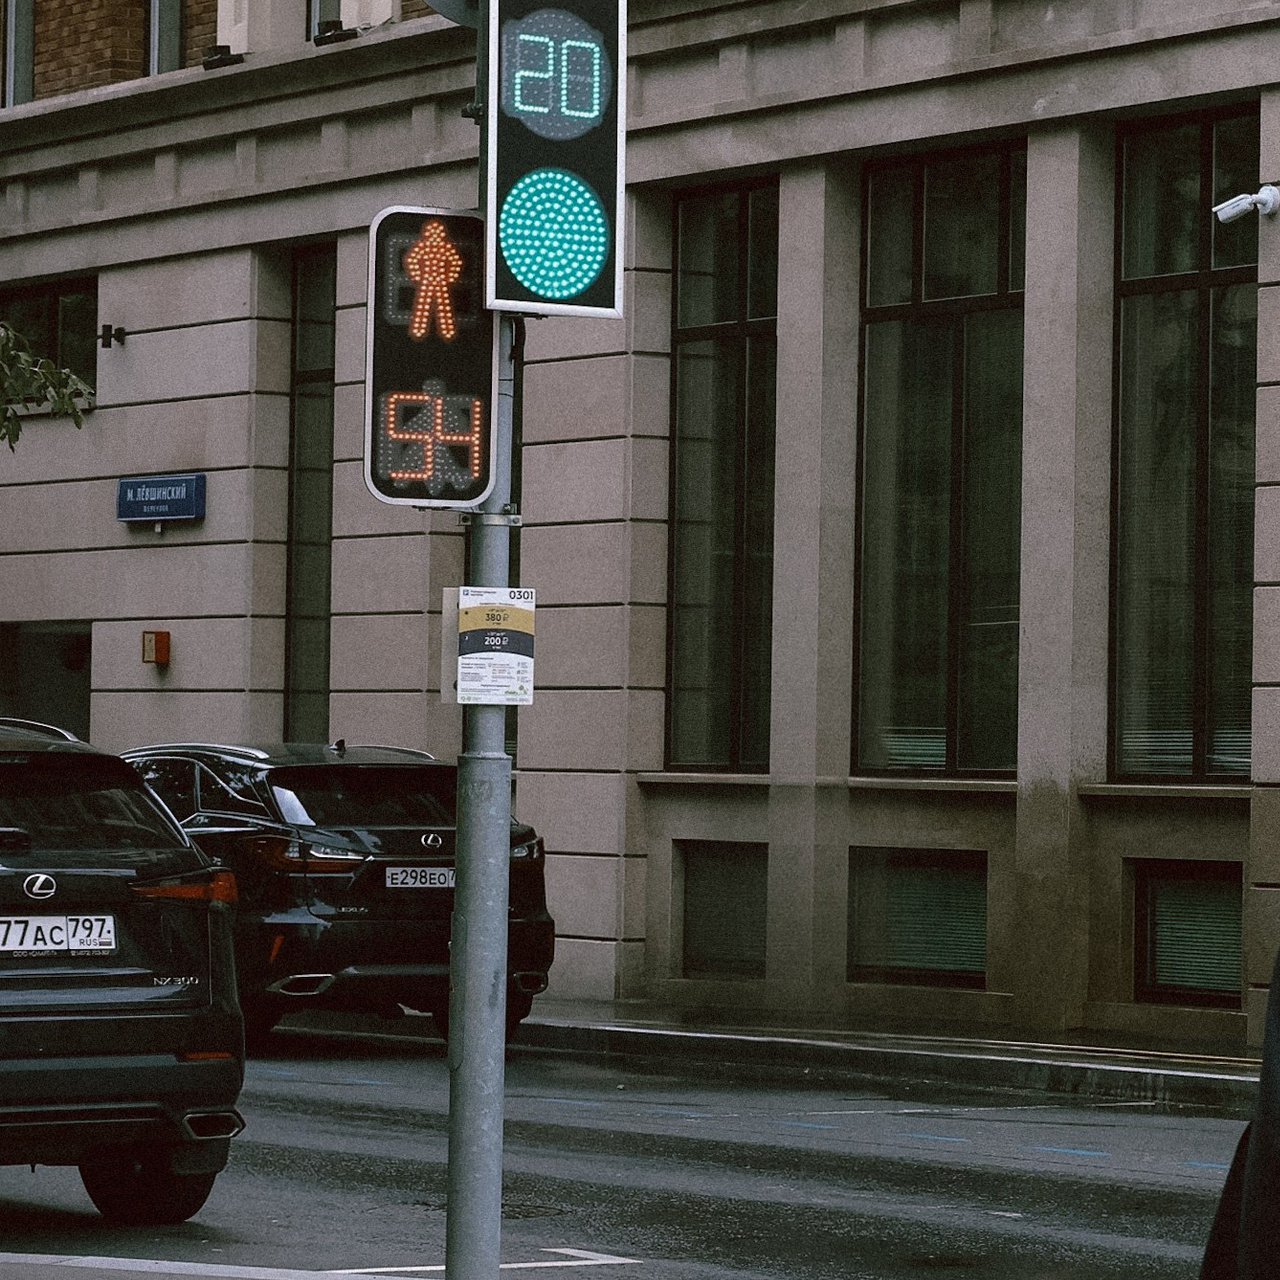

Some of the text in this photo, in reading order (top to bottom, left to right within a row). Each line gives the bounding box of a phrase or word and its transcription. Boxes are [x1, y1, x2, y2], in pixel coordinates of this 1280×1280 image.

[514, 33, 600, 119] 20
[387, 392, 481, 480] 54
[509, 590, 533, 600] 0301
[485, 613, 502, 621] 380
[484, 636, 501, 645] 200
[68, 918, 106, 938] 797
[79, 938, 98, 947] RUS
